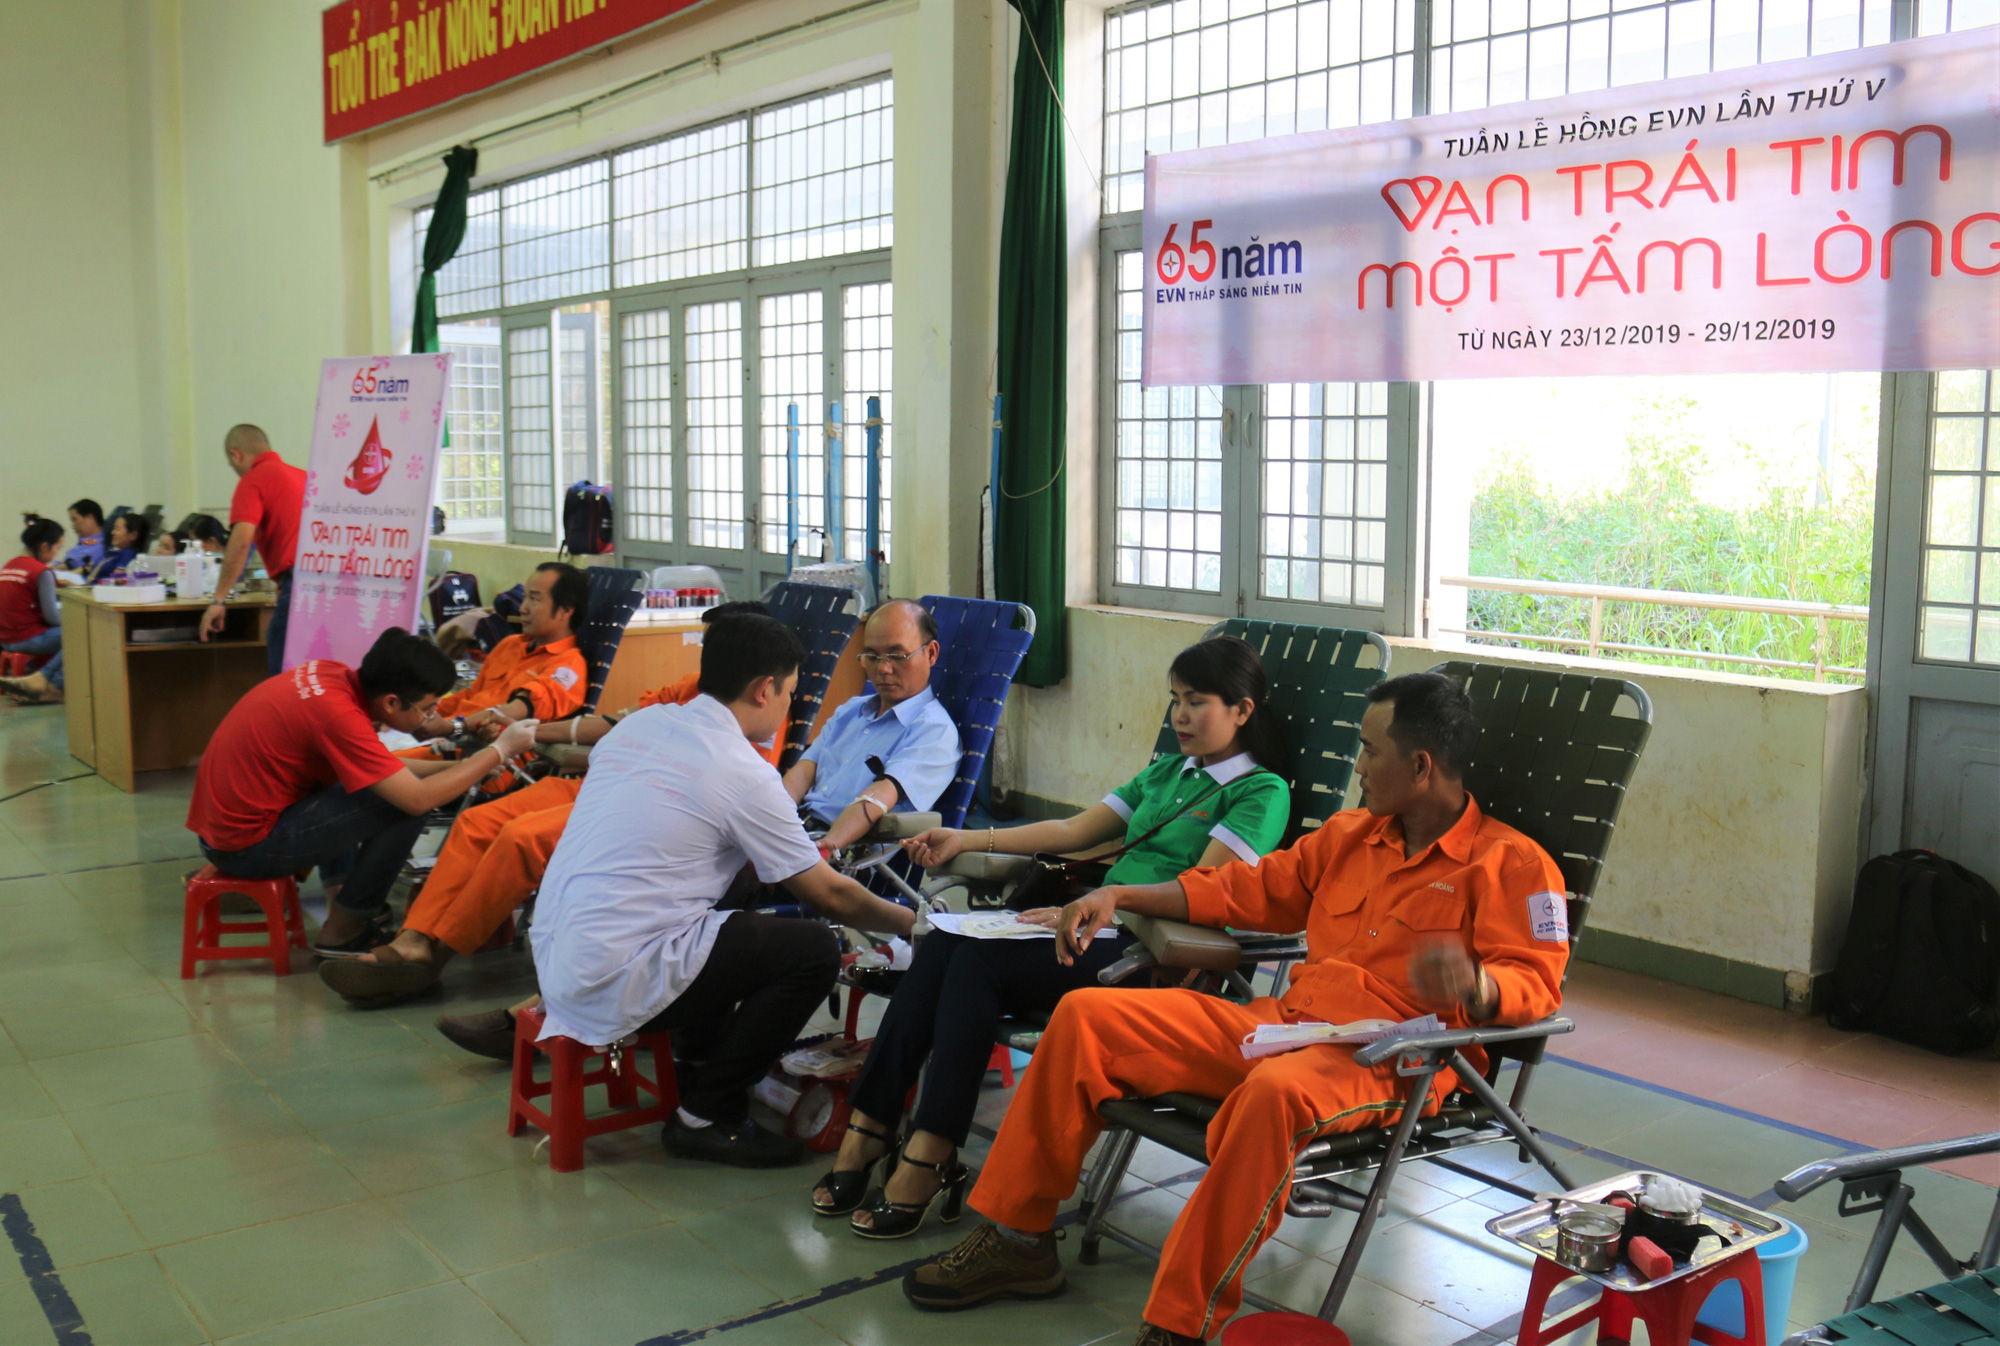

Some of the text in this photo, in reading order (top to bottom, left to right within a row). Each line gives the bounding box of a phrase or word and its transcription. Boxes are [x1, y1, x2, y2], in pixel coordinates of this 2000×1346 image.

[1444, 78, 1886, 158] TUẦN LỄ HỒNG EVN LẦN THỨ V
[1556, 138, 1737, 217] TRÁI
[1769, 124, 1952, 196] TIM
[1157, 288, 1186, 303] EVN
[1219, 285, 1248, 299] SÁNG
[1284, 283, 1303, 295] TIN
[1358, 246, 1516, 313] MỘT
[1538, 221, 1722, 298] TẤM
[1458, 328, 1485, 351] TỪ
[1492, 325, 1553, 350] NGÀY
[1704, 318, 1836, 343] 29/12/2019
[373, 553, 414, 581] LÒNG
